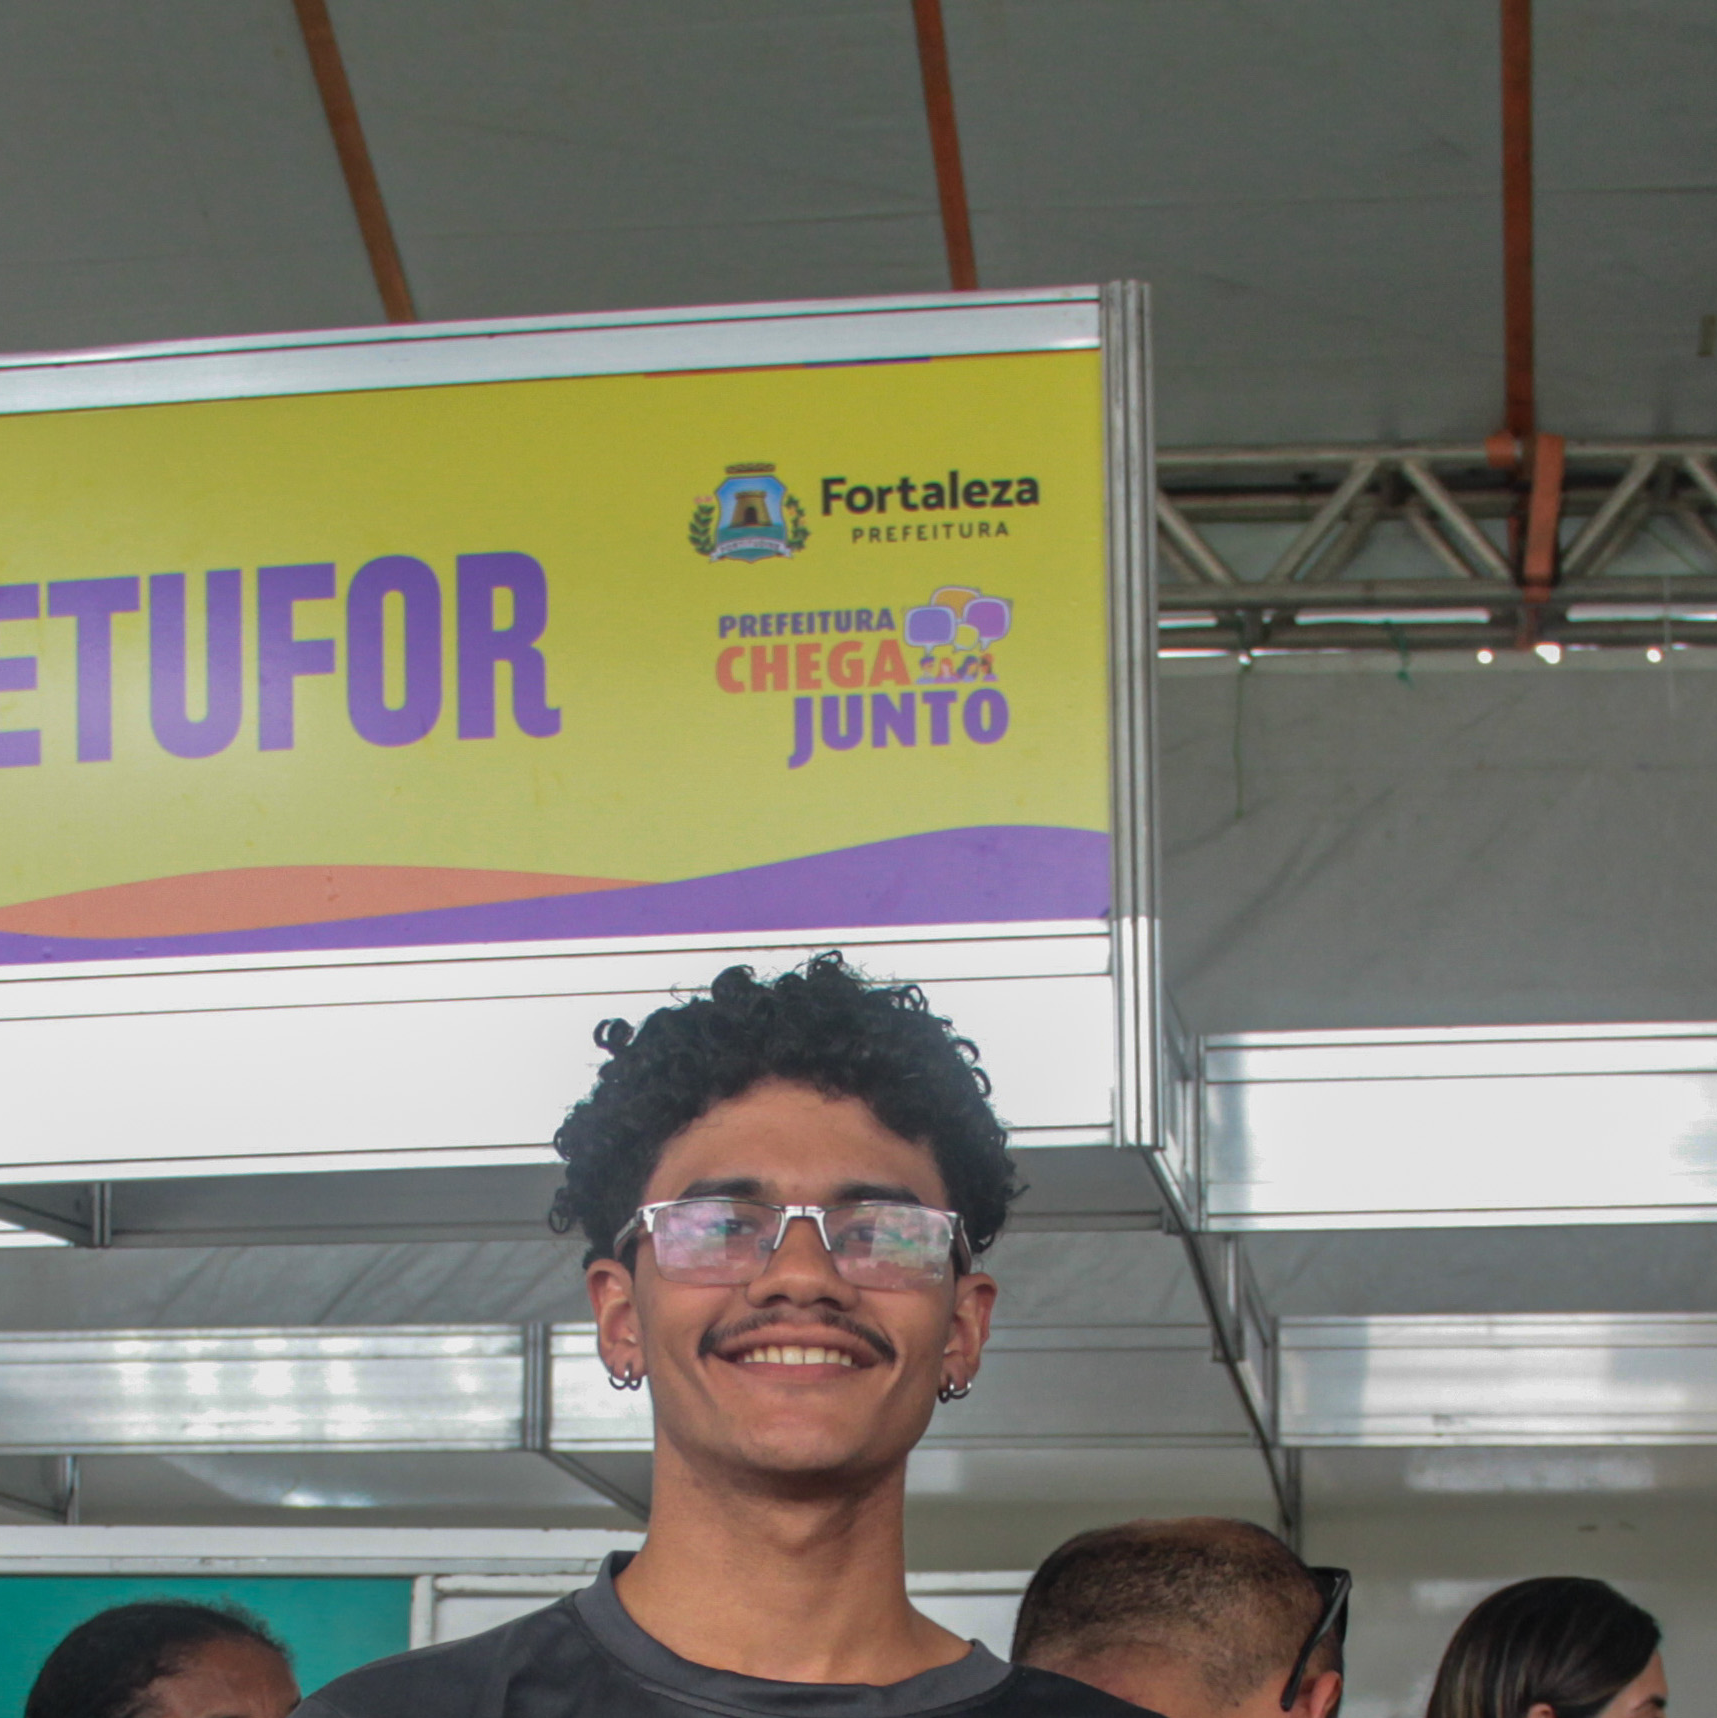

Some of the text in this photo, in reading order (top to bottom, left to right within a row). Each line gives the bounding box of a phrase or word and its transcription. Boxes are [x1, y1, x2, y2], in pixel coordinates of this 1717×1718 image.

[820, 470, 1040, 517] Fortaleza
[852, 521, 1010, 544] PREFEITURA
[718, 607, 897, 639] PREFEITURA
[715, 638, 912, 694] CHEGA
[787, 687, 1010, 770] JUNTO
